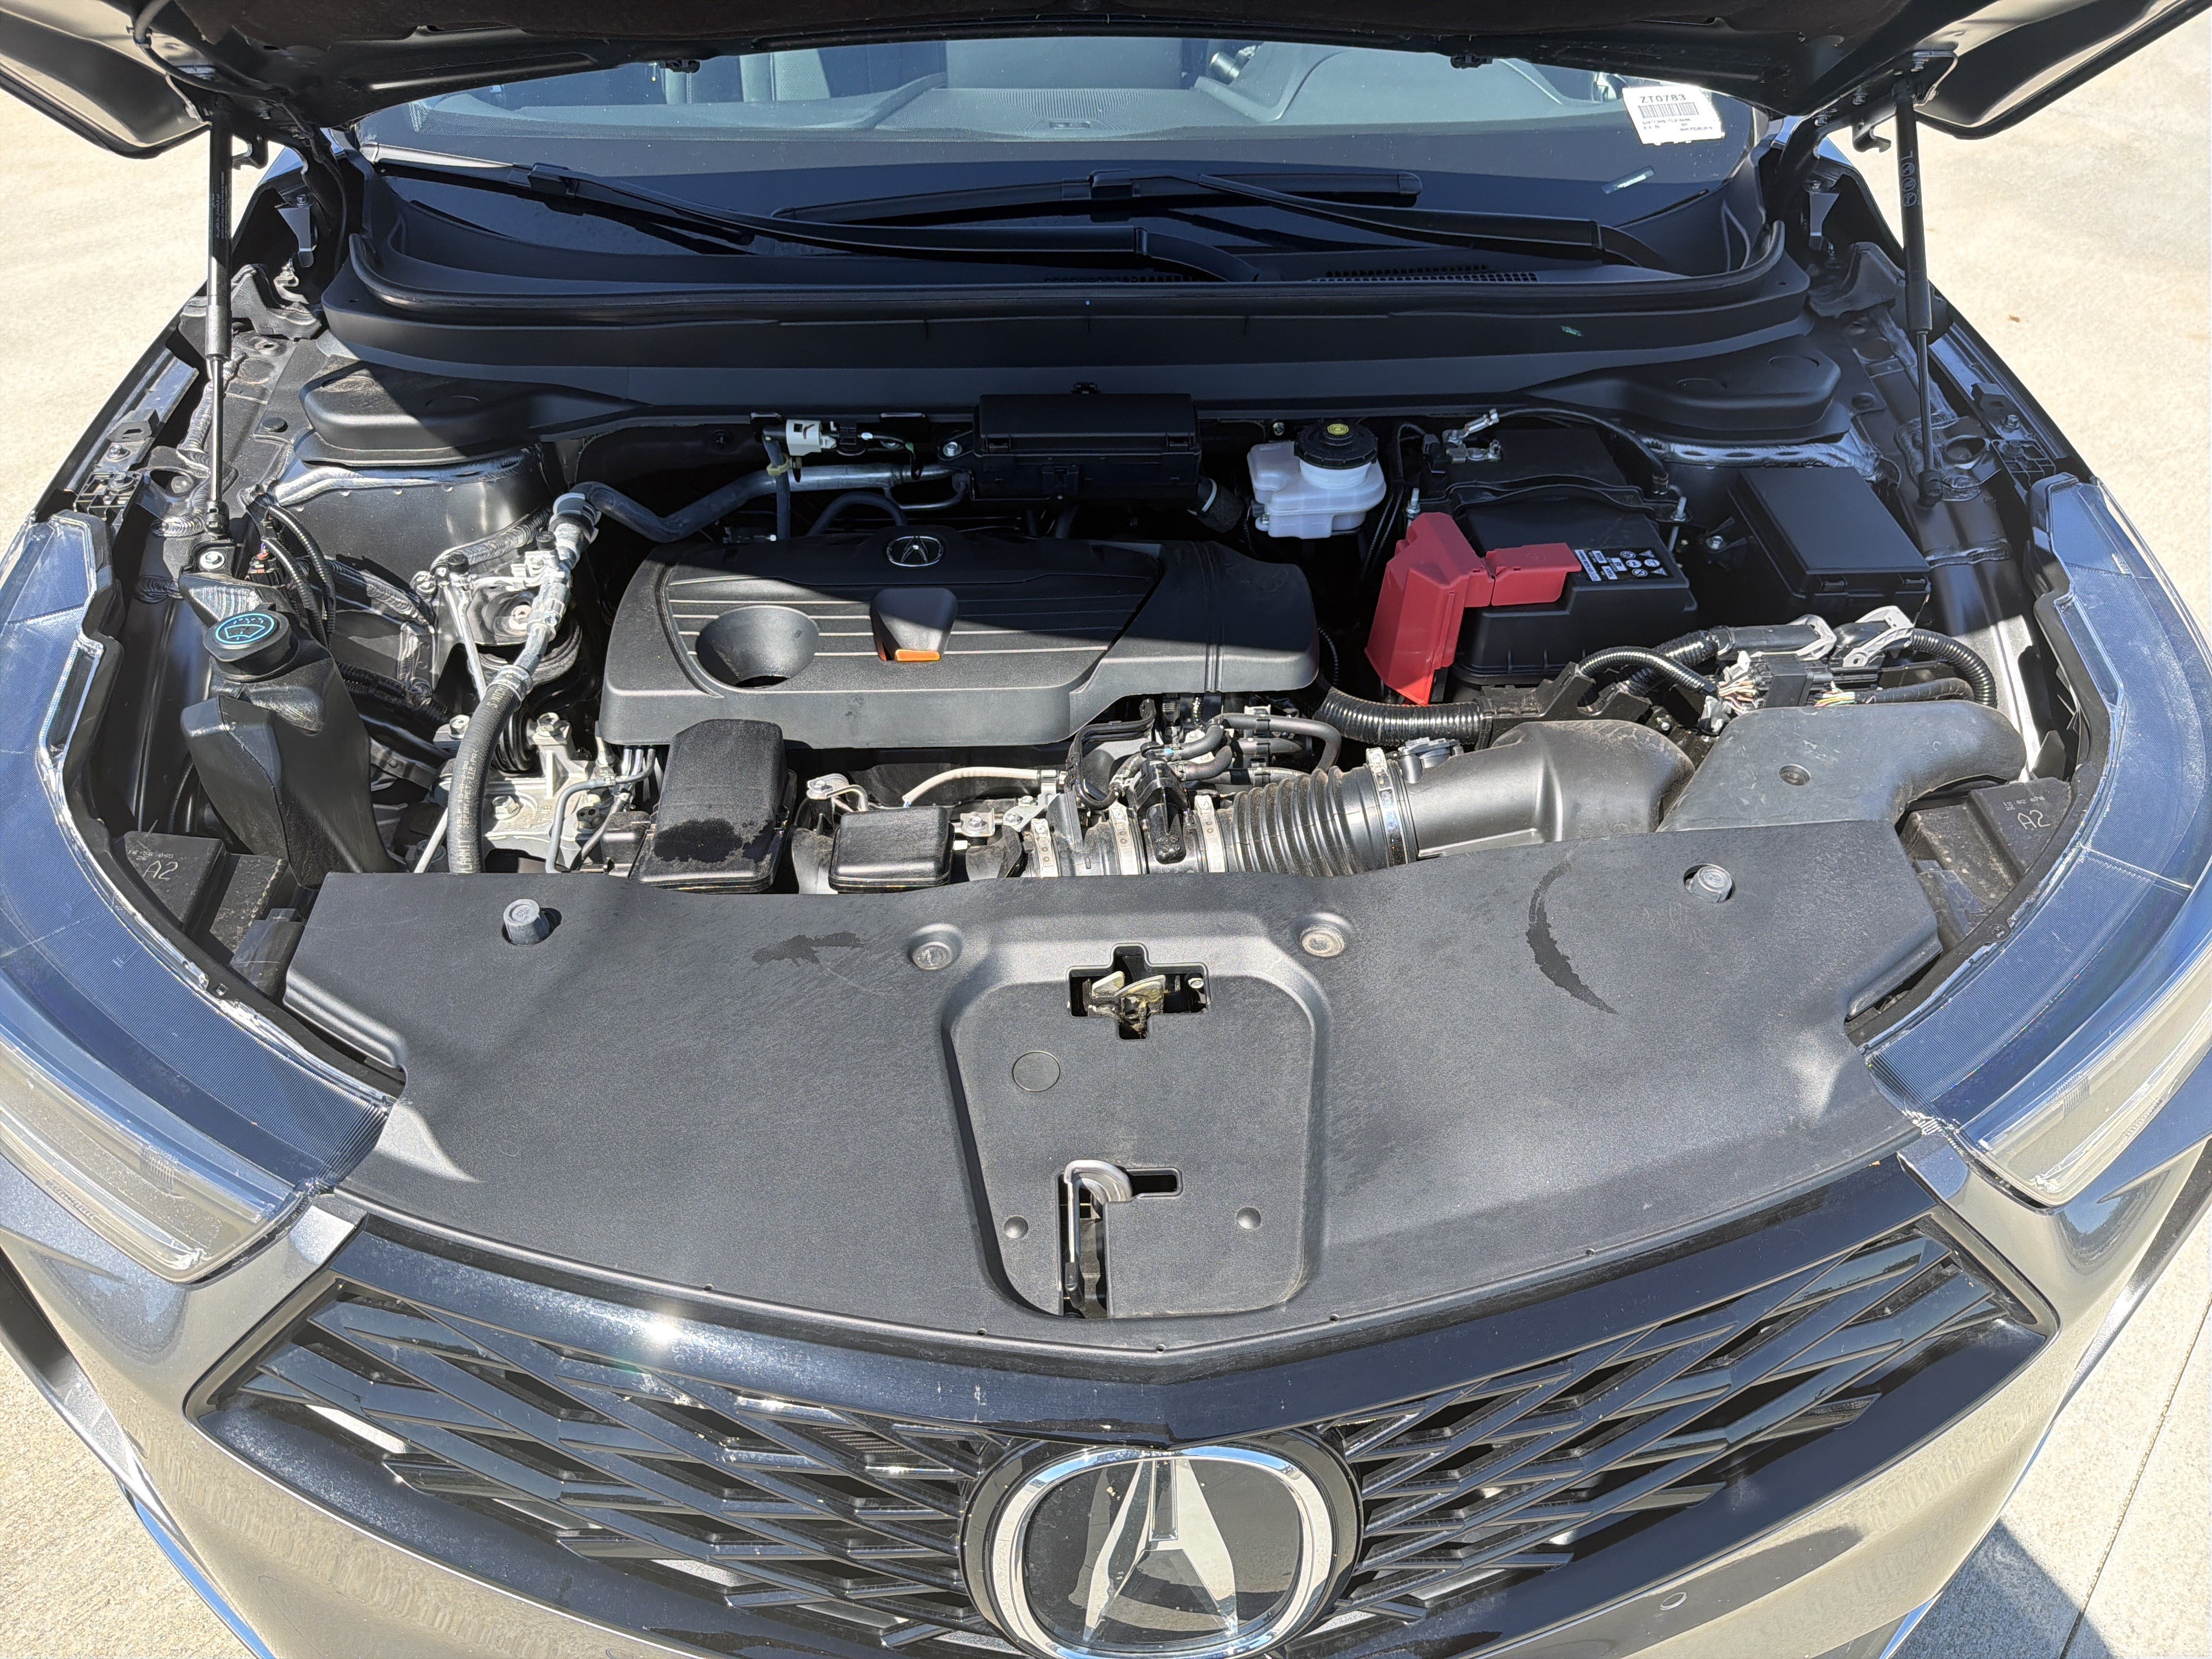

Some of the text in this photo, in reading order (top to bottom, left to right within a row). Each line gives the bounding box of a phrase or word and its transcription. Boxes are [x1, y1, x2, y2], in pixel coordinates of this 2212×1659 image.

[1639, 94, 1686, 104] ZT0783
[2017, 809, 2051, 830] A2
[142, 860, 178, 881] A2
